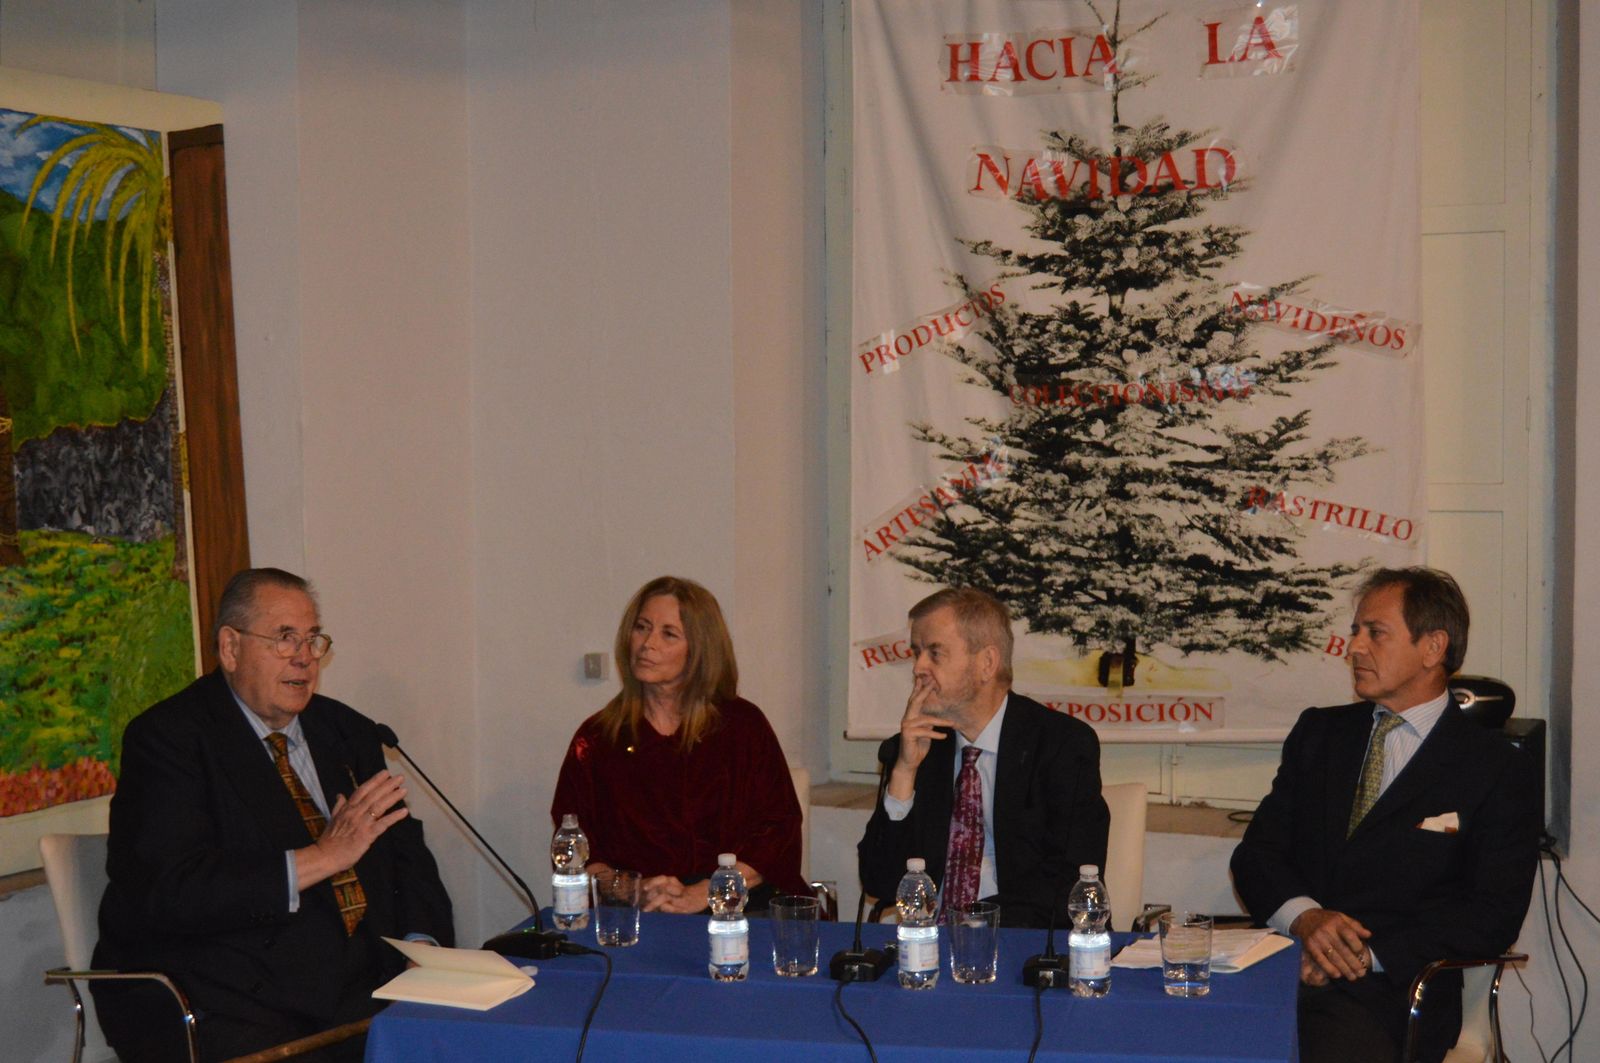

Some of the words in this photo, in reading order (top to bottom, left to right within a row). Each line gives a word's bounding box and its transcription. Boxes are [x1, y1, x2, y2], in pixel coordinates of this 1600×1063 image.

[945, 34, 1121, 83] HACIA
[1203, 16, 1284, 65] LA
[969, 147, 1236, 200] NAVIDAD
[859, 283, 1006, 374] PRODUCTOS
[1227, 289, 1405, 350] NAVIDEÑOS
[1244, 486, 1413, 541] RASTRILLO
[861, 640, 913, 668] REG
[1044, 697, 1214, 723] POSICIÓN
